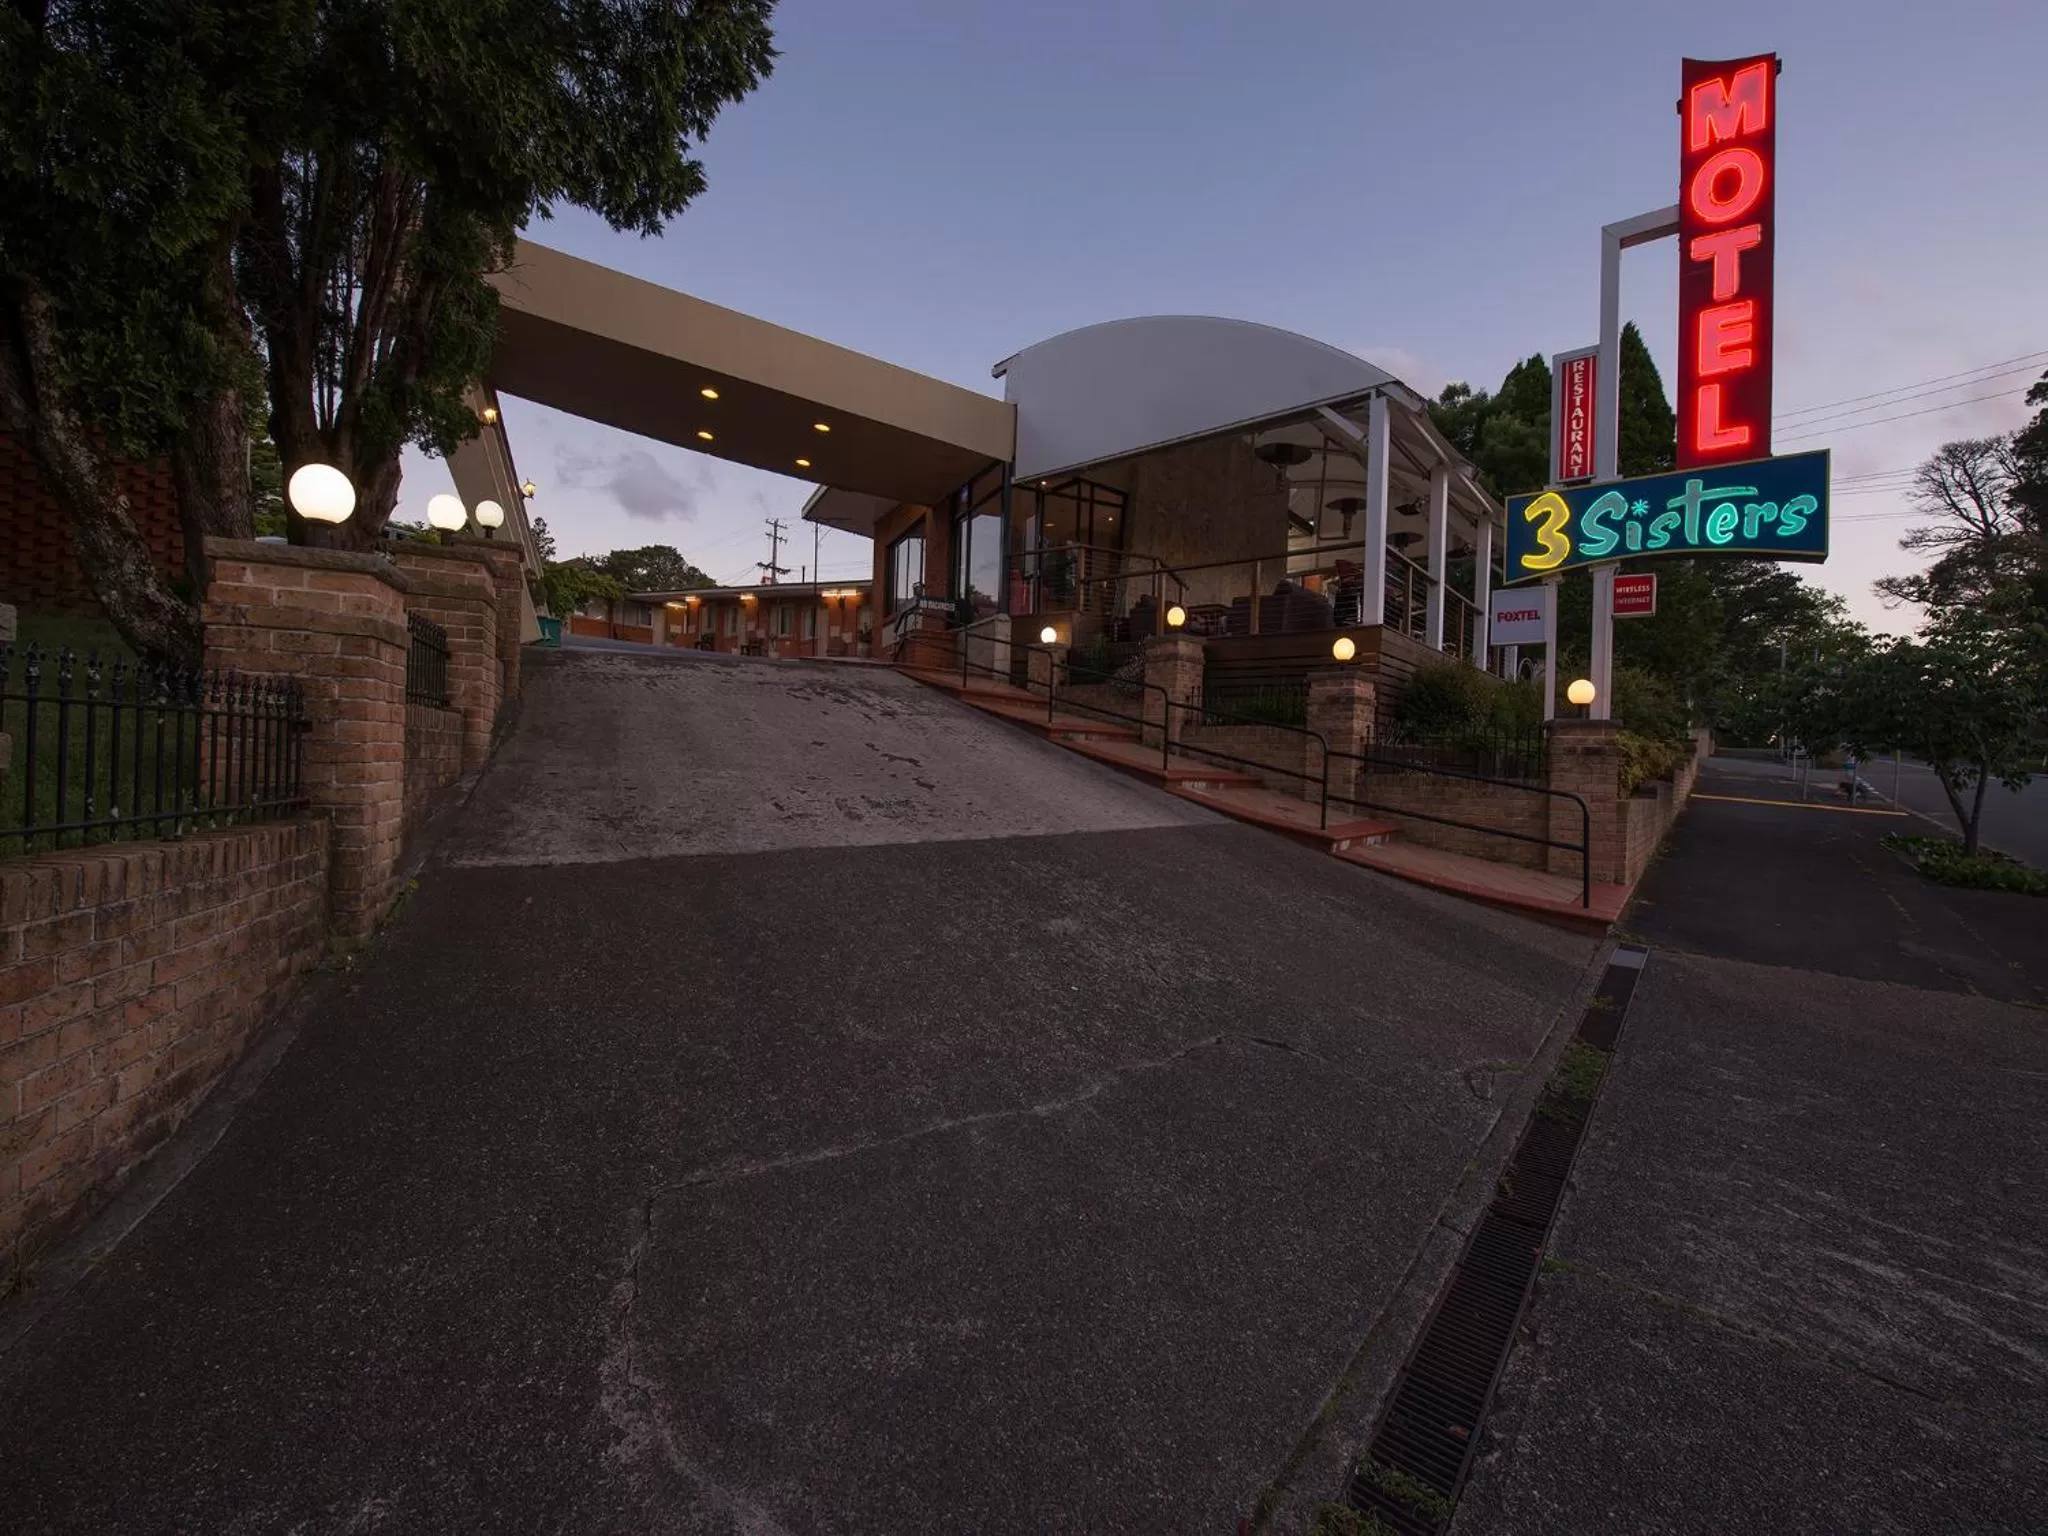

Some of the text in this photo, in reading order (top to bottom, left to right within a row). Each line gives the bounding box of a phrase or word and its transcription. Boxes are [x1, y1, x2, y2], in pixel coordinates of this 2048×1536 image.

[1690, 62, 1767, 450] MOTEL
[1570, 359, 1585, 477] RESTAURANT
[1521, 479, 1818, 569] 3 Sisters
[1497, 609, 1541, 623] FOXTEL
[1615, 584, 1650, 593] WIRELESS
